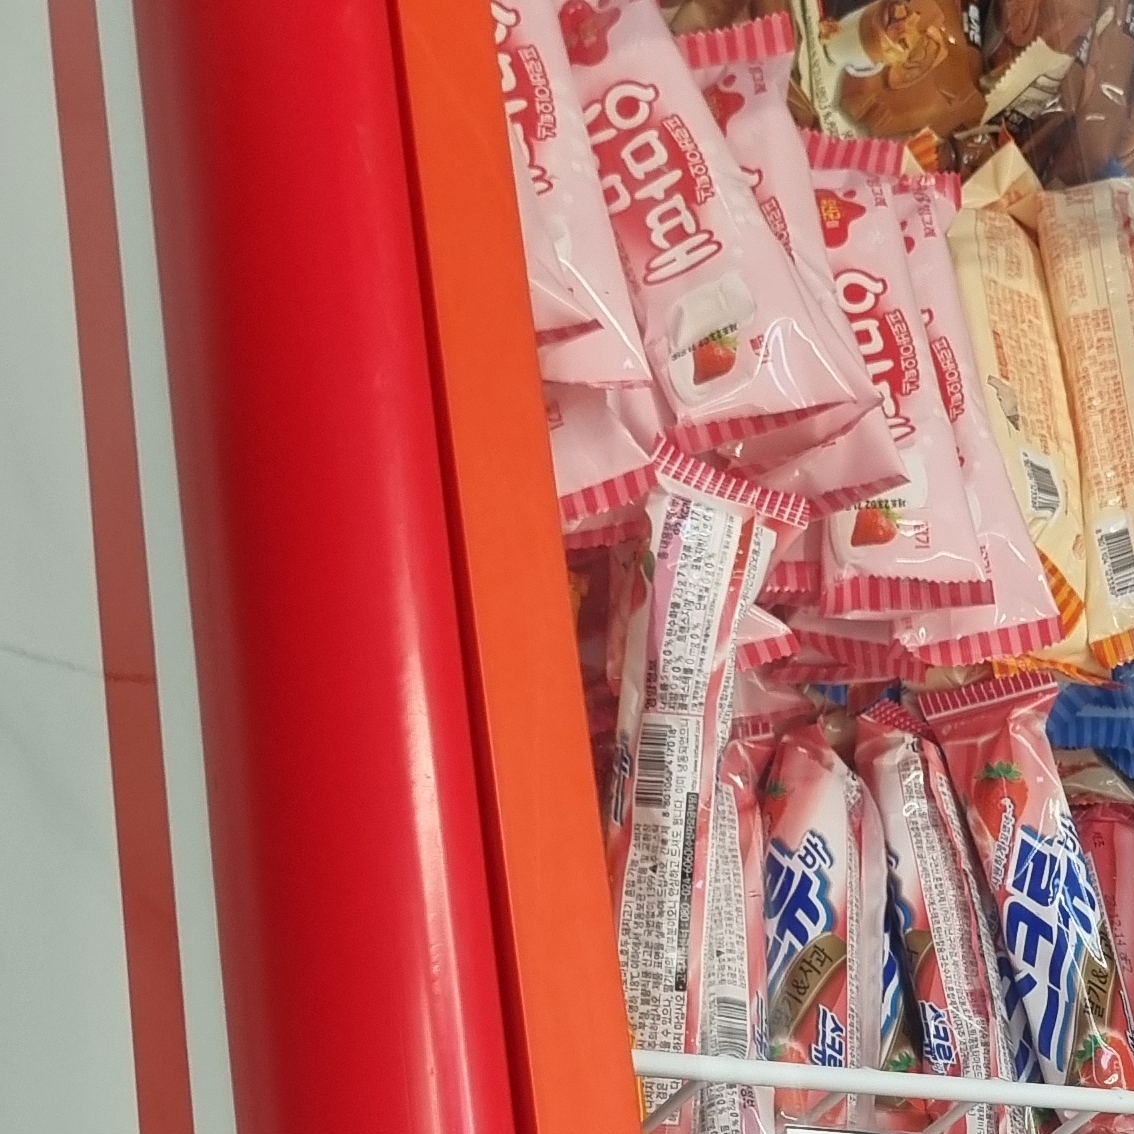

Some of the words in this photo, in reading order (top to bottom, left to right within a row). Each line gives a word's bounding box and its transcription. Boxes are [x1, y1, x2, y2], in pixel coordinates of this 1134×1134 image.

[665, 116, 715, 203] 프로바이오틱스
[676, 498, 691, 520] kcal
[665, 601, 679, 637] 탄수화물
[661, 657, 673, 673] mg
[662, 648, 672, 656] 0
[642, 659, 660, 710] 영양정보
[626, 859, 637, 876] 가능
[667, 860, 682, 897] 안심하고
